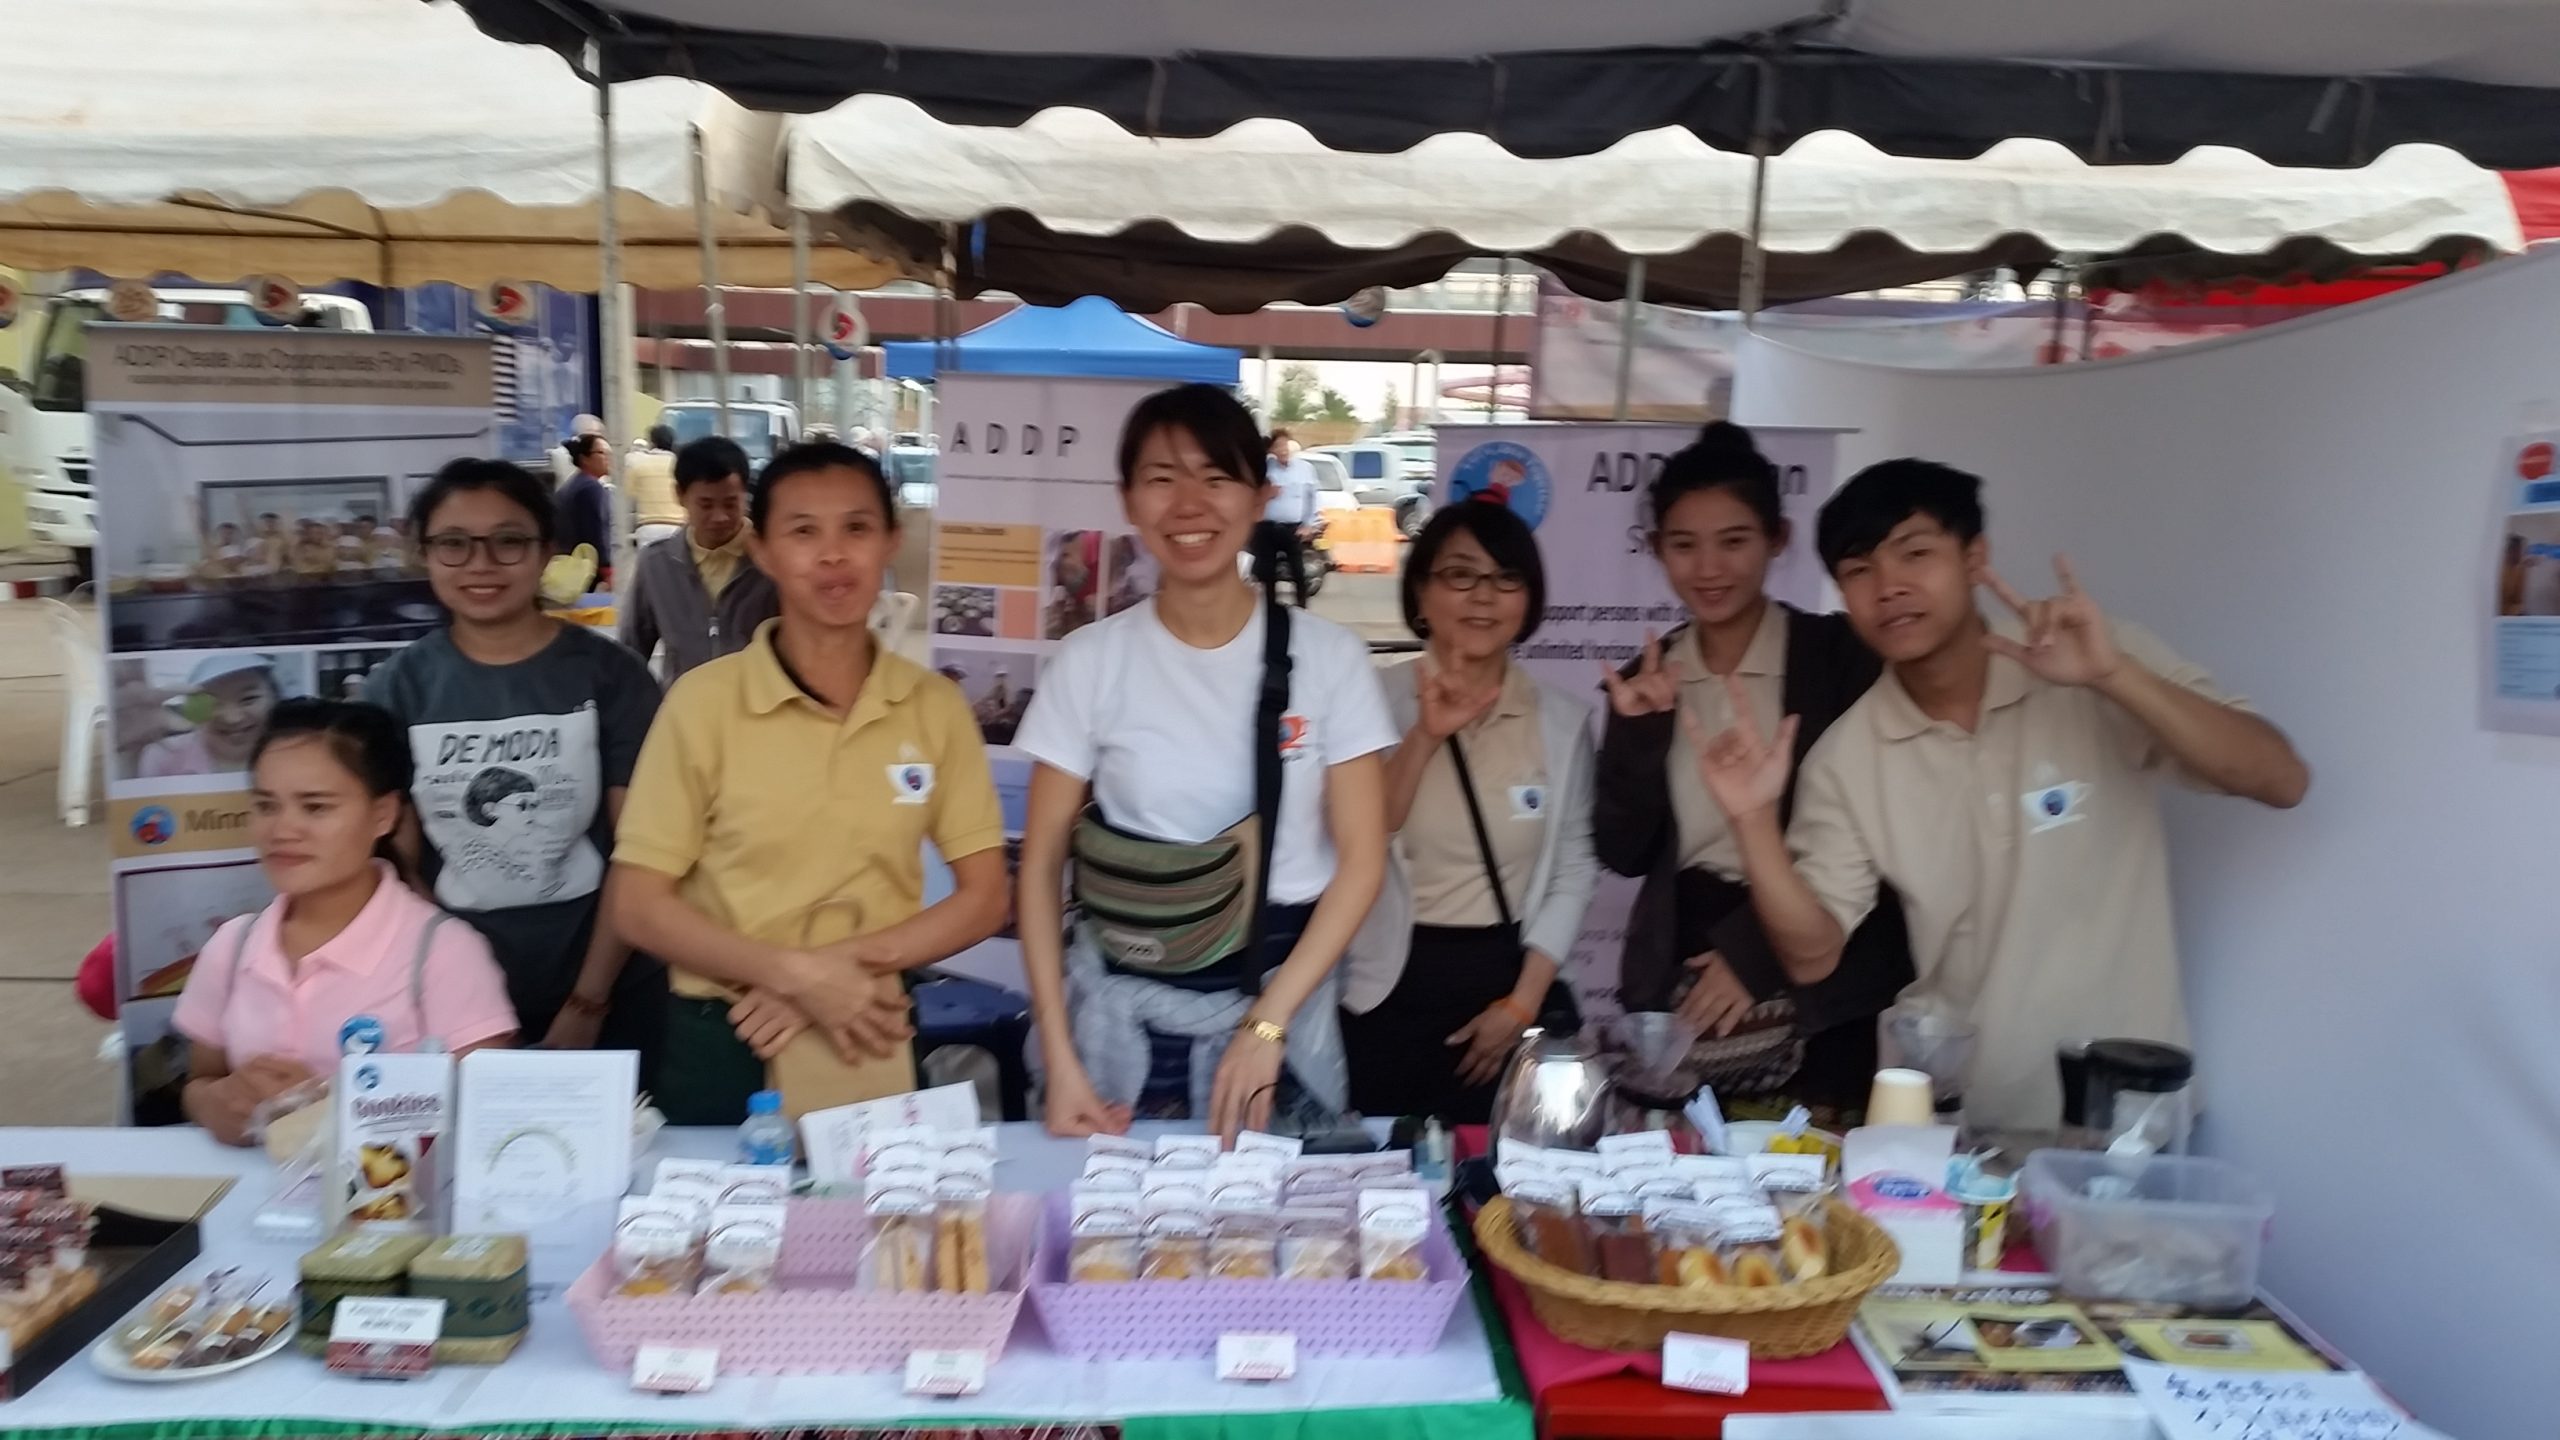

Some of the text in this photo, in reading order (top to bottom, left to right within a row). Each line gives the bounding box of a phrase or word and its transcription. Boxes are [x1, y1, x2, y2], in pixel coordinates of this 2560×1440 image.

[1588, 605, 1639, 626] persons
[1646, 602, 1671, 622] with
[184, 809, 251, 832] Minn
